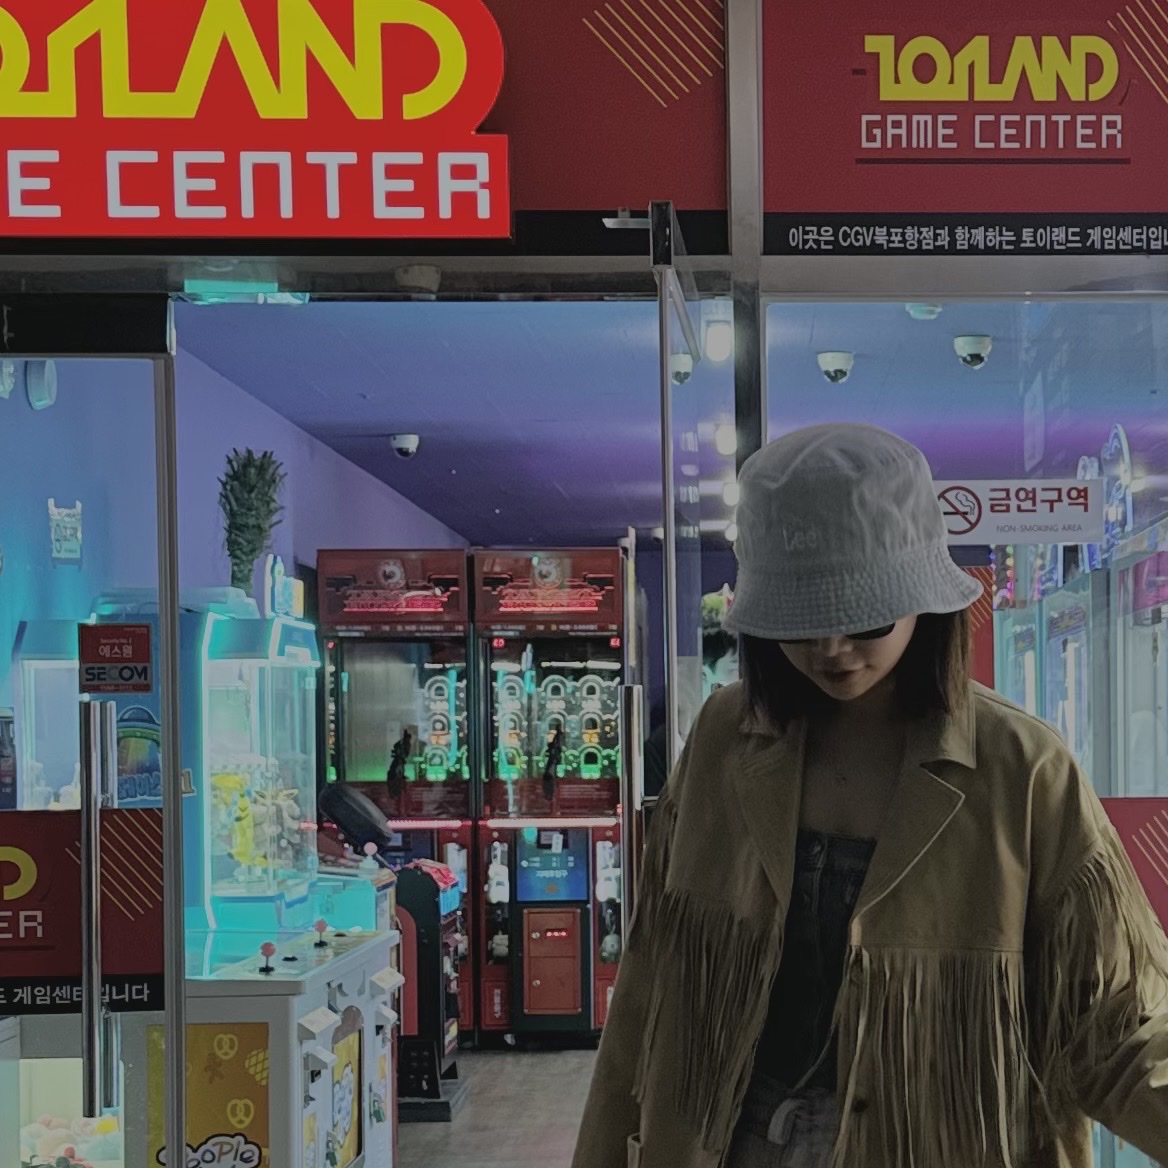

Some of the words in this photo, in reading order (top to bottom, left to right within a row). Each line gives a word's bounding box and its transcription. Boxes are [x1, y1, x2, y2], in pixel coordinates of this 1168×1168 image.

[861, 115, 958, 149] GAME
[974, 115, 1122, 149] CENTER
[106, 150, 490, 219] CENTER
[788, 226, 835, 249] 이곳은
[838, 226, 950, 250] CGV북포항점과
[954, 226, 1017, 250] 함께하는
[1020, 227, 1082, 249] 토이랜드
[988, 486, 1089, 513] 금연구역
[1061, 522, 1083, 532] AREA
[98, 644, 133, 658] 에스원
[85, 665, 149, 682] SECOM
